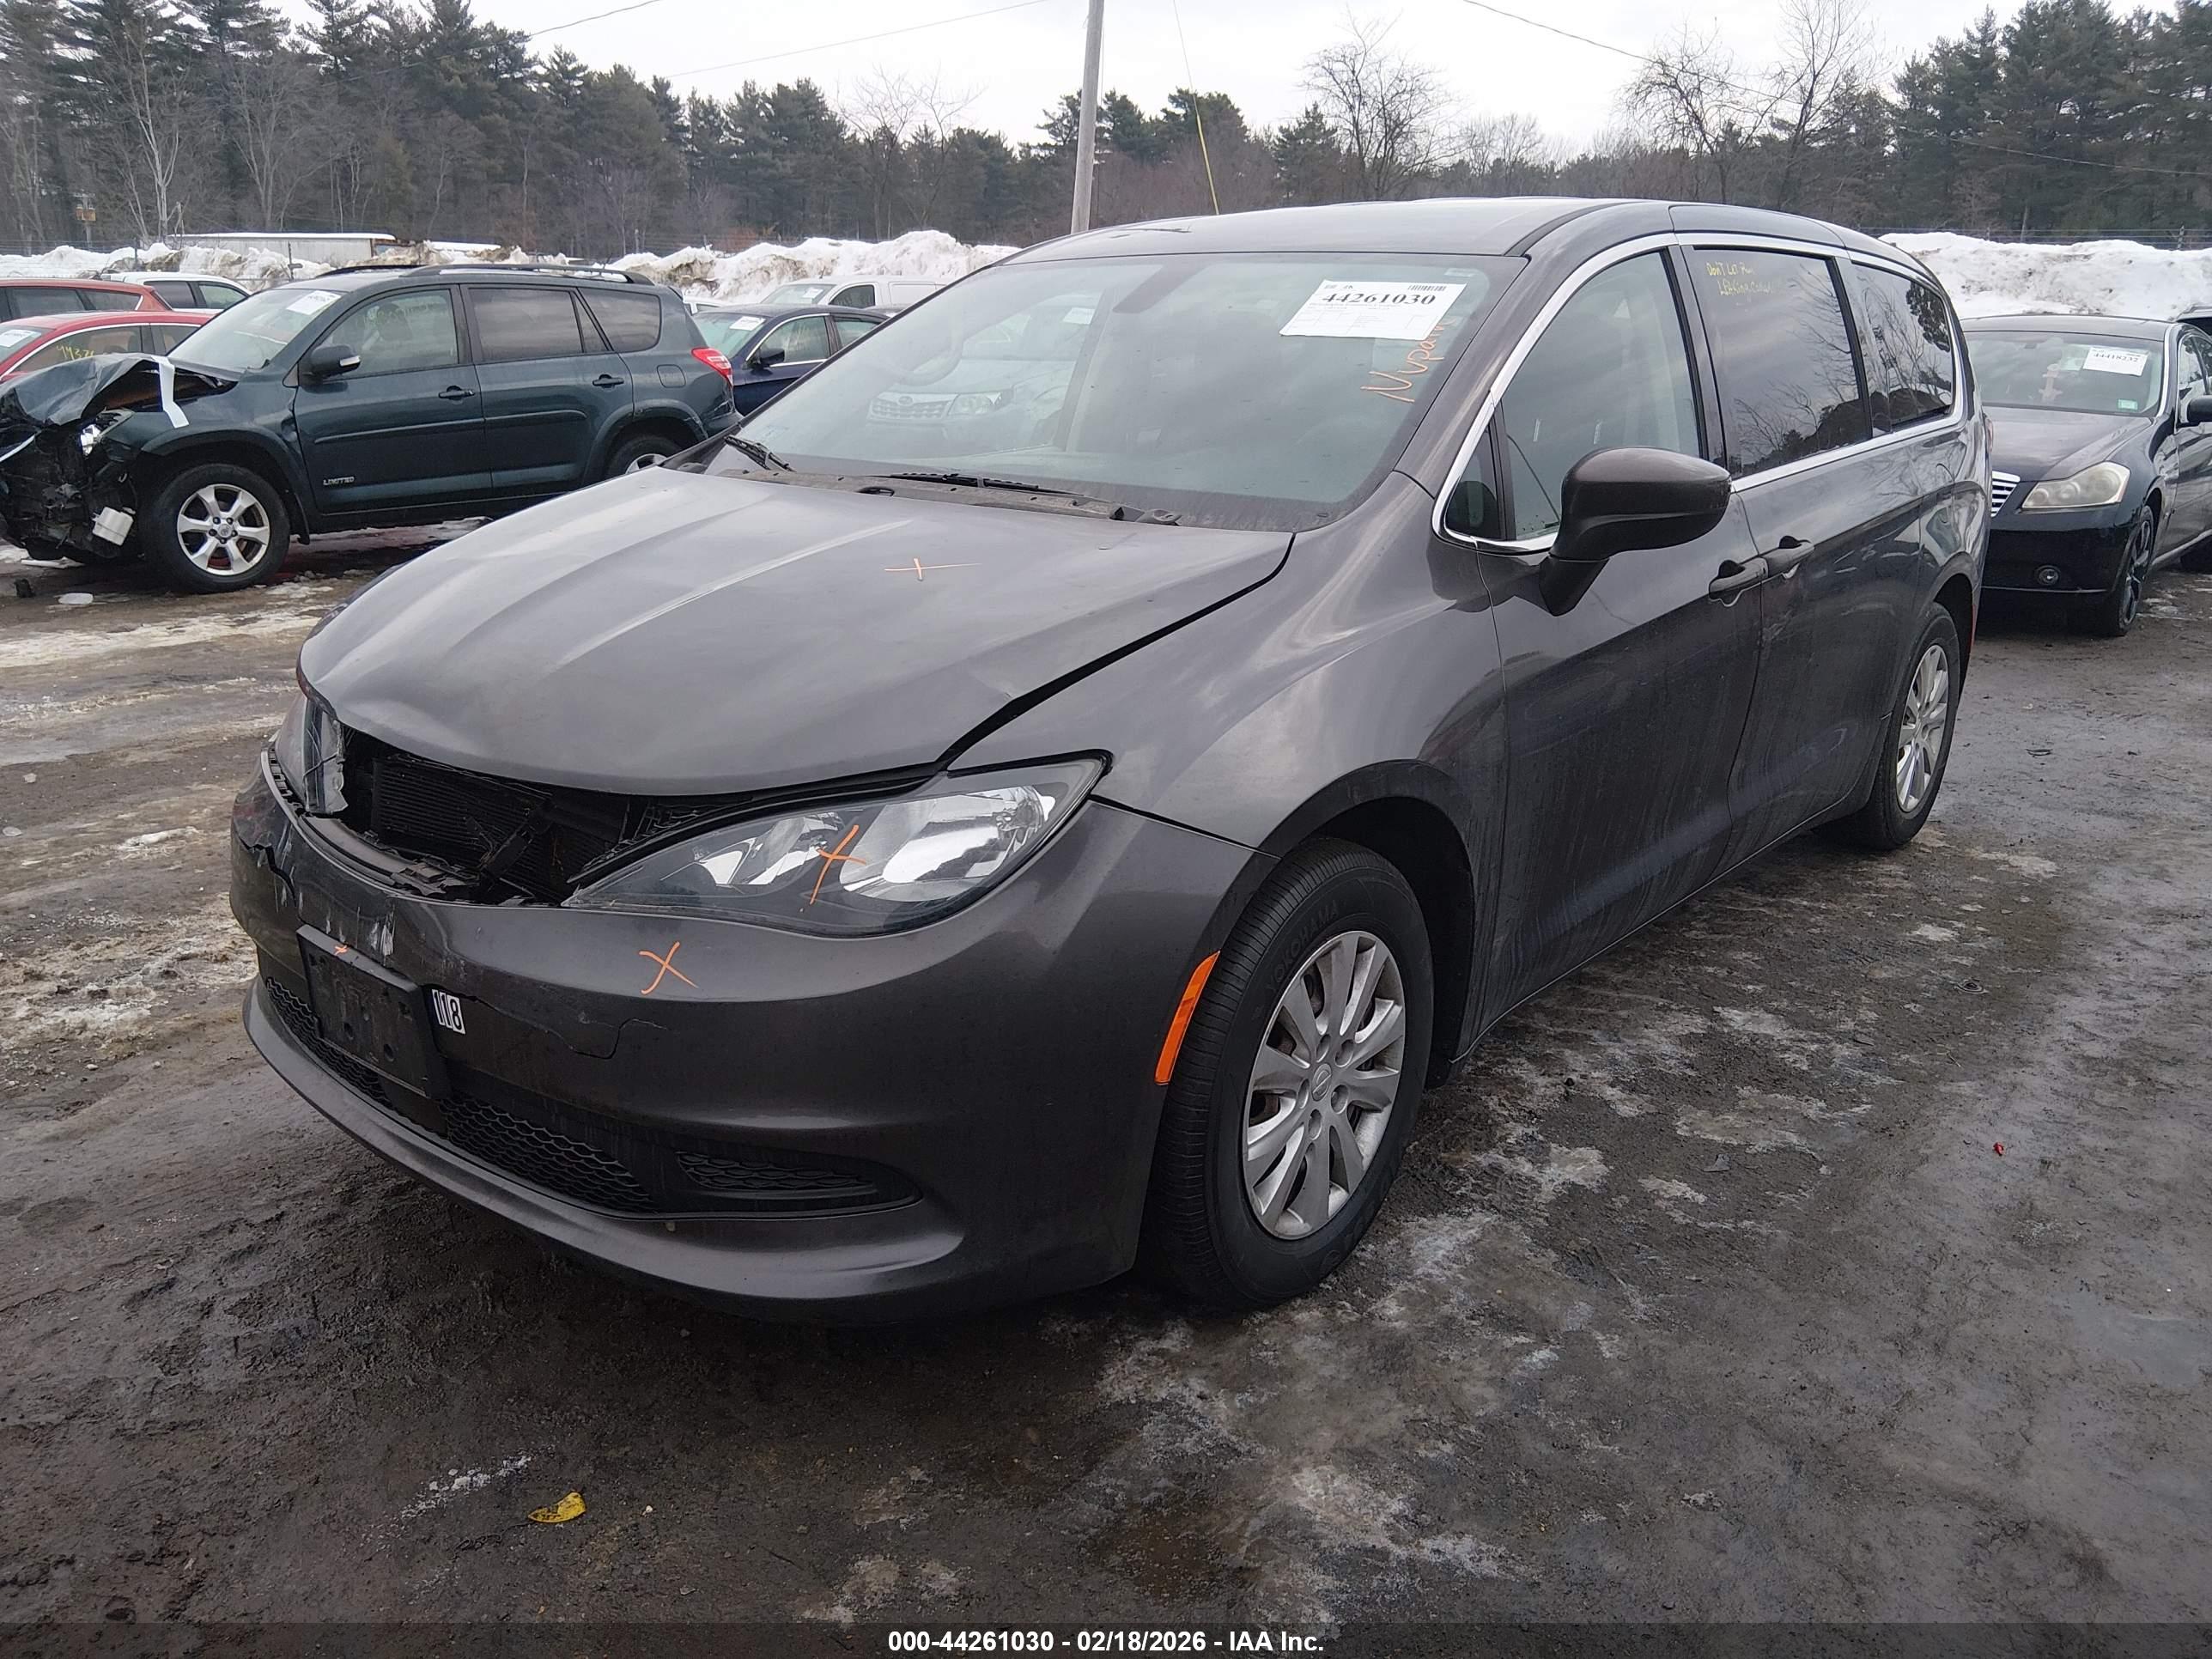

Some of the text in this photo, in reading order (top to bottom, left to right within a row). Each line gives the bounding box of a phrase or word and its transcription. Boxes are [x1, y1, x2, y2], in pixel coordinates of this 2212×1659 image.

[1322, 293, 1437, 305] 44261030
[323, 476, 355, 486] LIMITED
[434, 991, 463, 1031] 118
